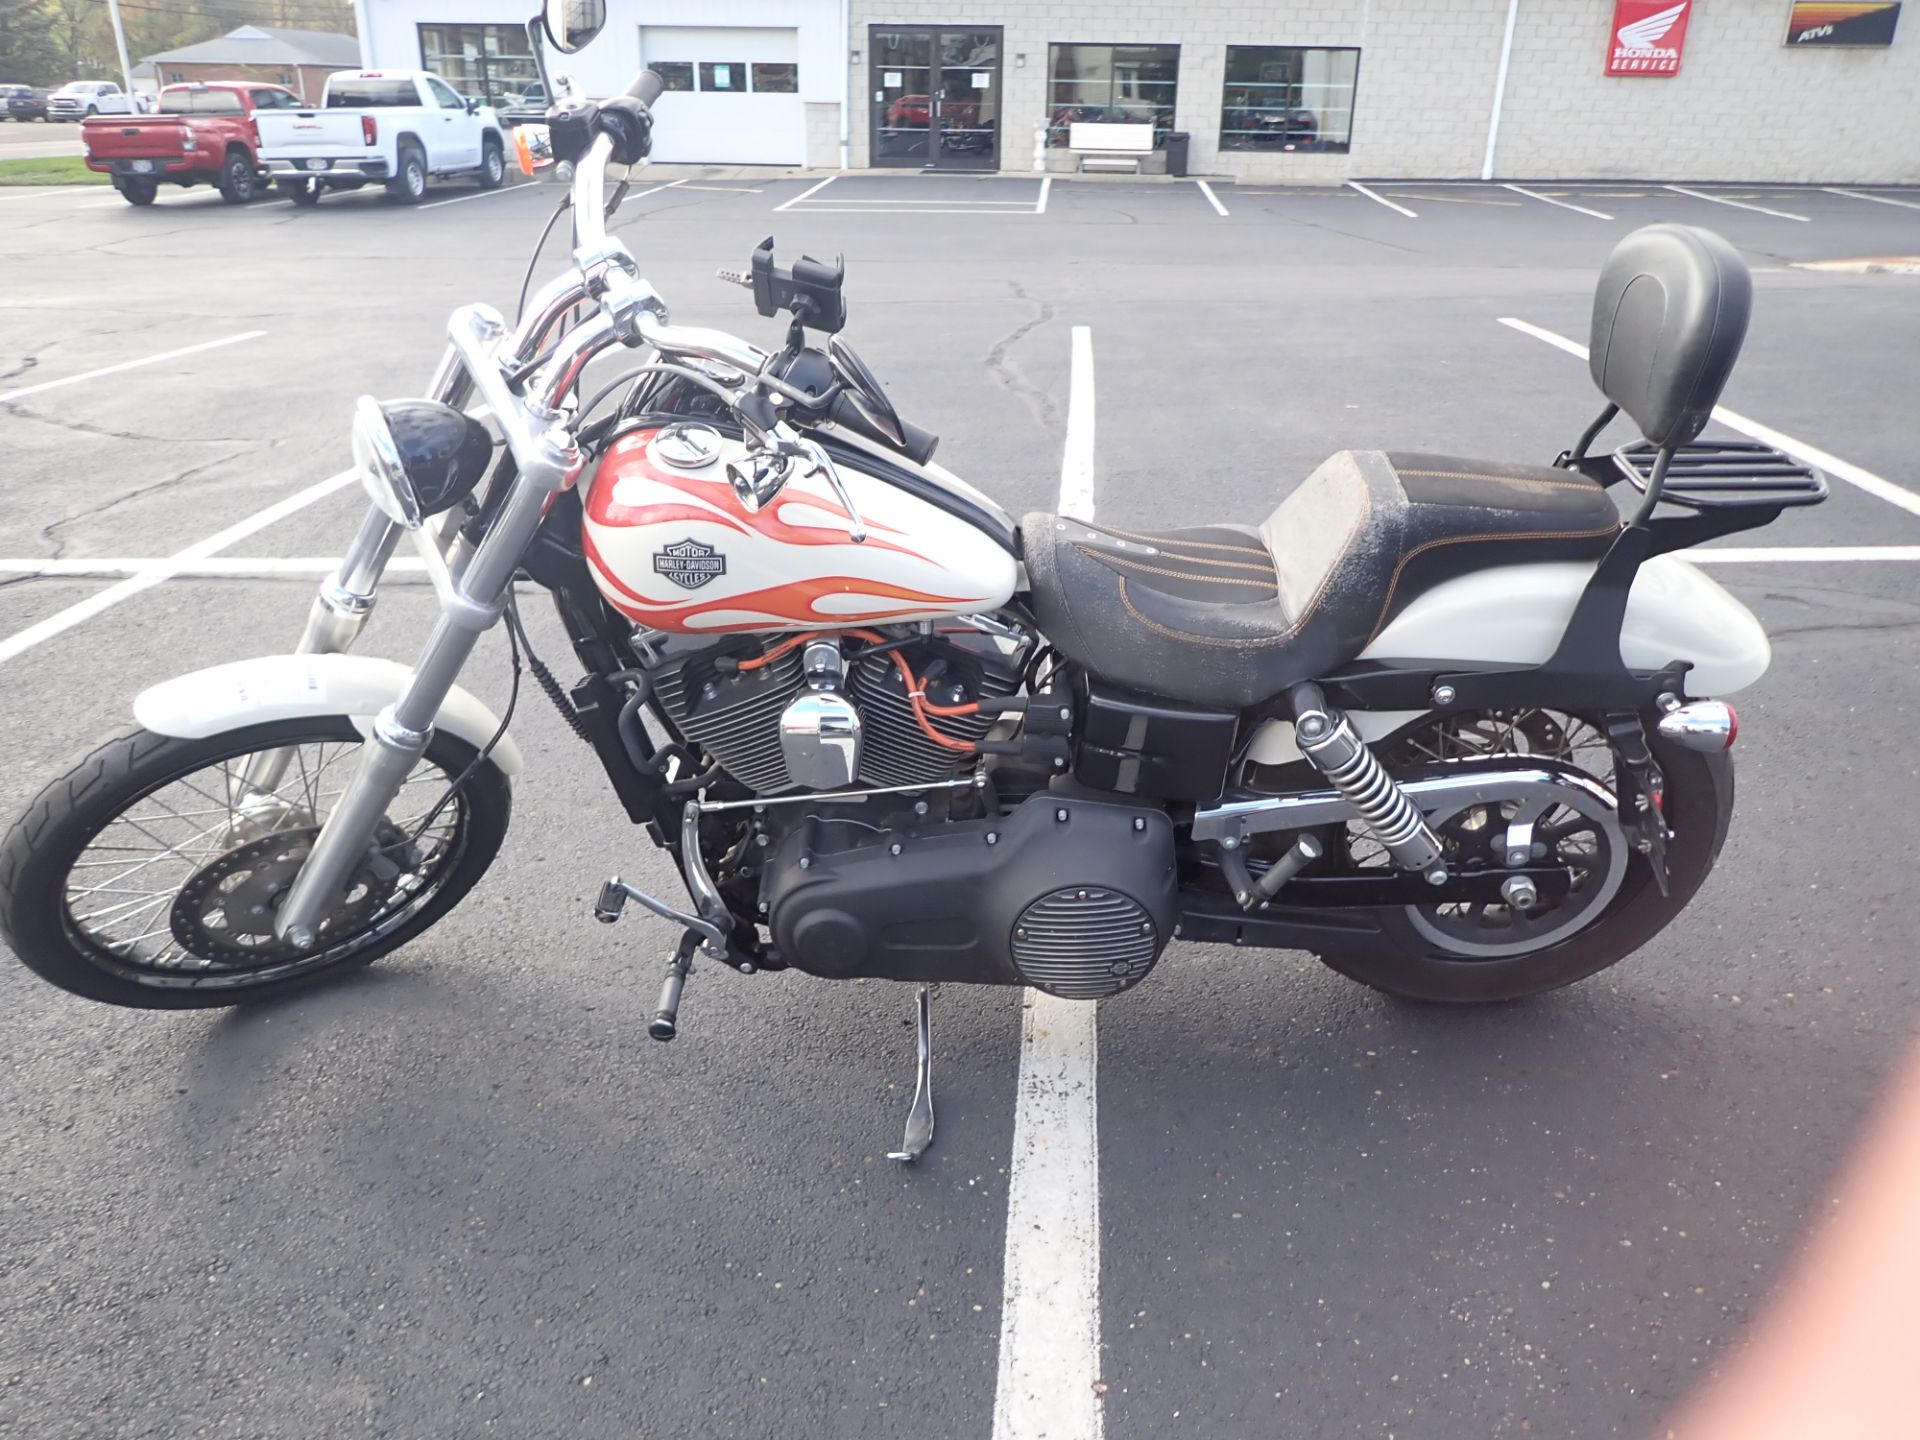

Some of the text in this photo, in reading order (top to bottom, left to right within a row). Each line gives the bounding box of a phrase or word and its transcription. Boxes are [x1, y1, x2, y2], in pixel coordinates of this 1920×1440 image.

[1798, 24, 1834, 42] ATVs
[1613, 48, 1678, 58] HONDA
[1611, 59, 1678, 70] SERVICE
[672, 546, 706, 557] MOTOR
[659, 559, 720, 570] HARLEY-DAVIDSON
[674, 572, 706, 585] CYCLES
